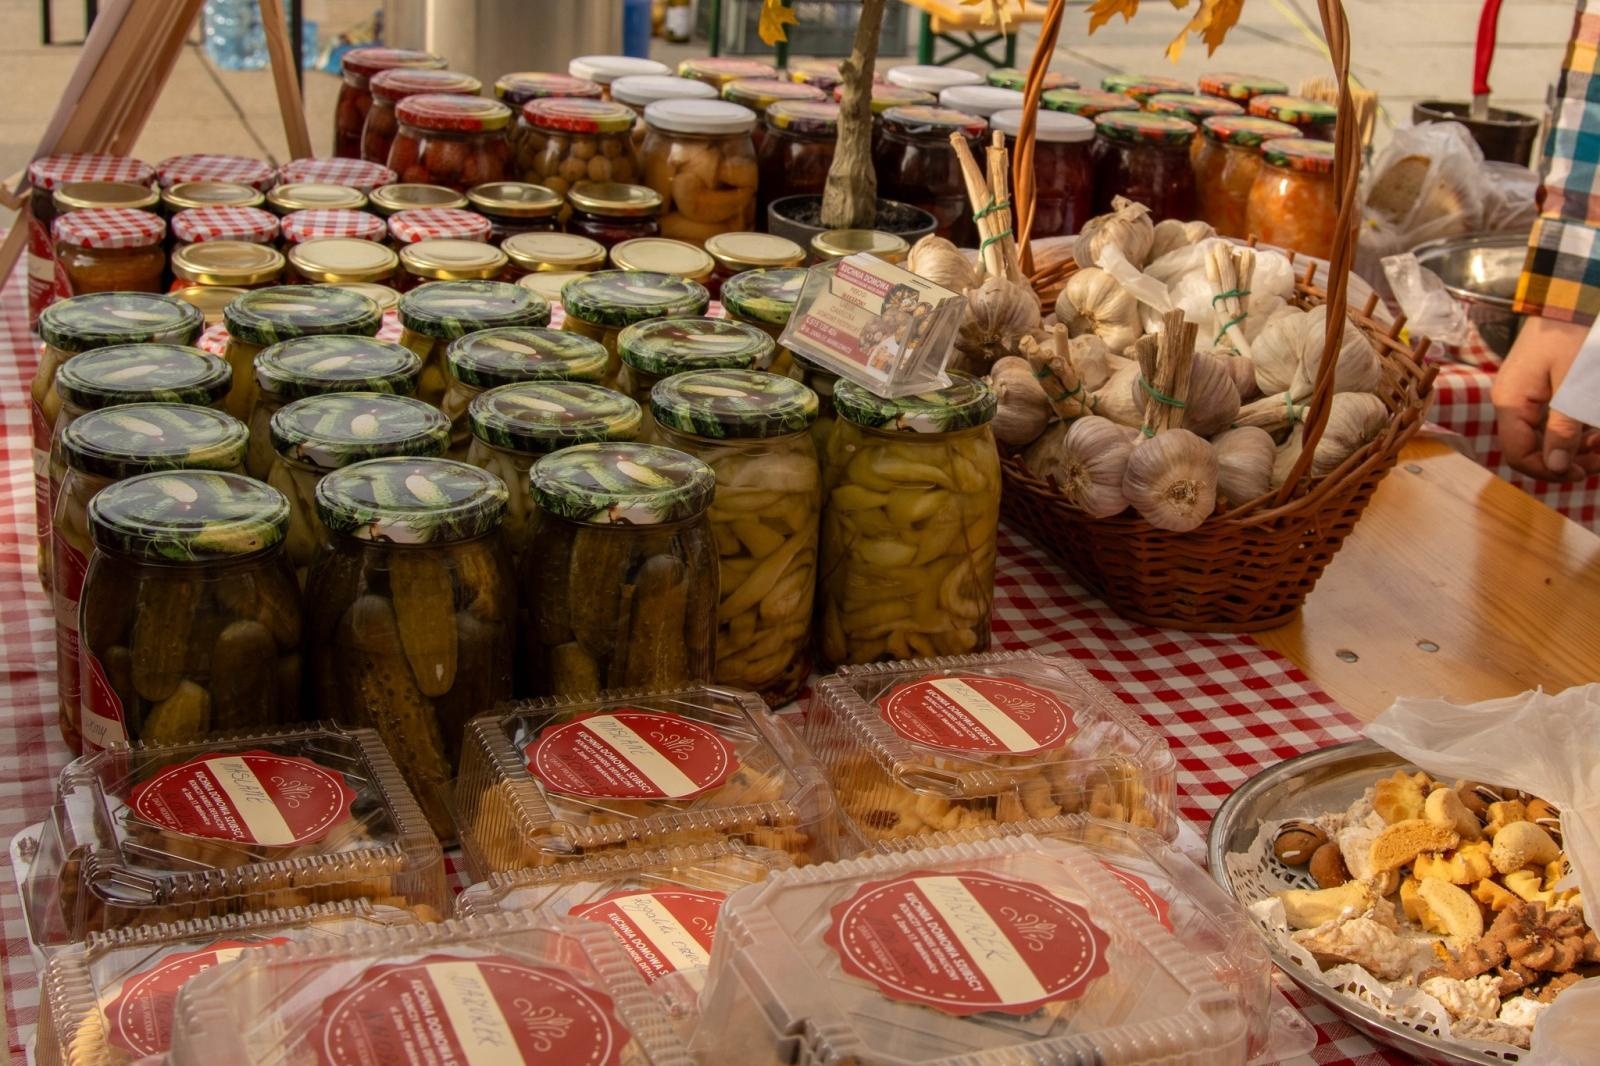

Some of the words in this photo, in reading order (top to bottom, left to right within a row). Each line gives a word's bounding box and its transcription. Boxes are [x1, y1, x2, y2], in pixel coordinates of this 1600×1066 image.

[944, 704, 975, 727] DOMOWA
[577, 731, 603, 749] KUCHNIA
[596, 747, 630, 772] DOMOWA
[623, 770, 654, 793] SZUBSCY
[195, 771, 214, 792] KUCHNIA
[208, 791, 231, 816] DOMOWA
[224, 815, 245, 838] SZUBSCY
[607, 912, 636, 939] KUCHNIA
[631, 938, 663, 970] DOMOWA
[904, 892, 933, 922] KUCHNIA
[927, 921, 959, 959] DOMOWA
[953, 959, 984, 991] SZUBSCY
[410, 979, 435, 1016] KUCHNIA
[426, 1017, 453, 1060] DOMOWA
